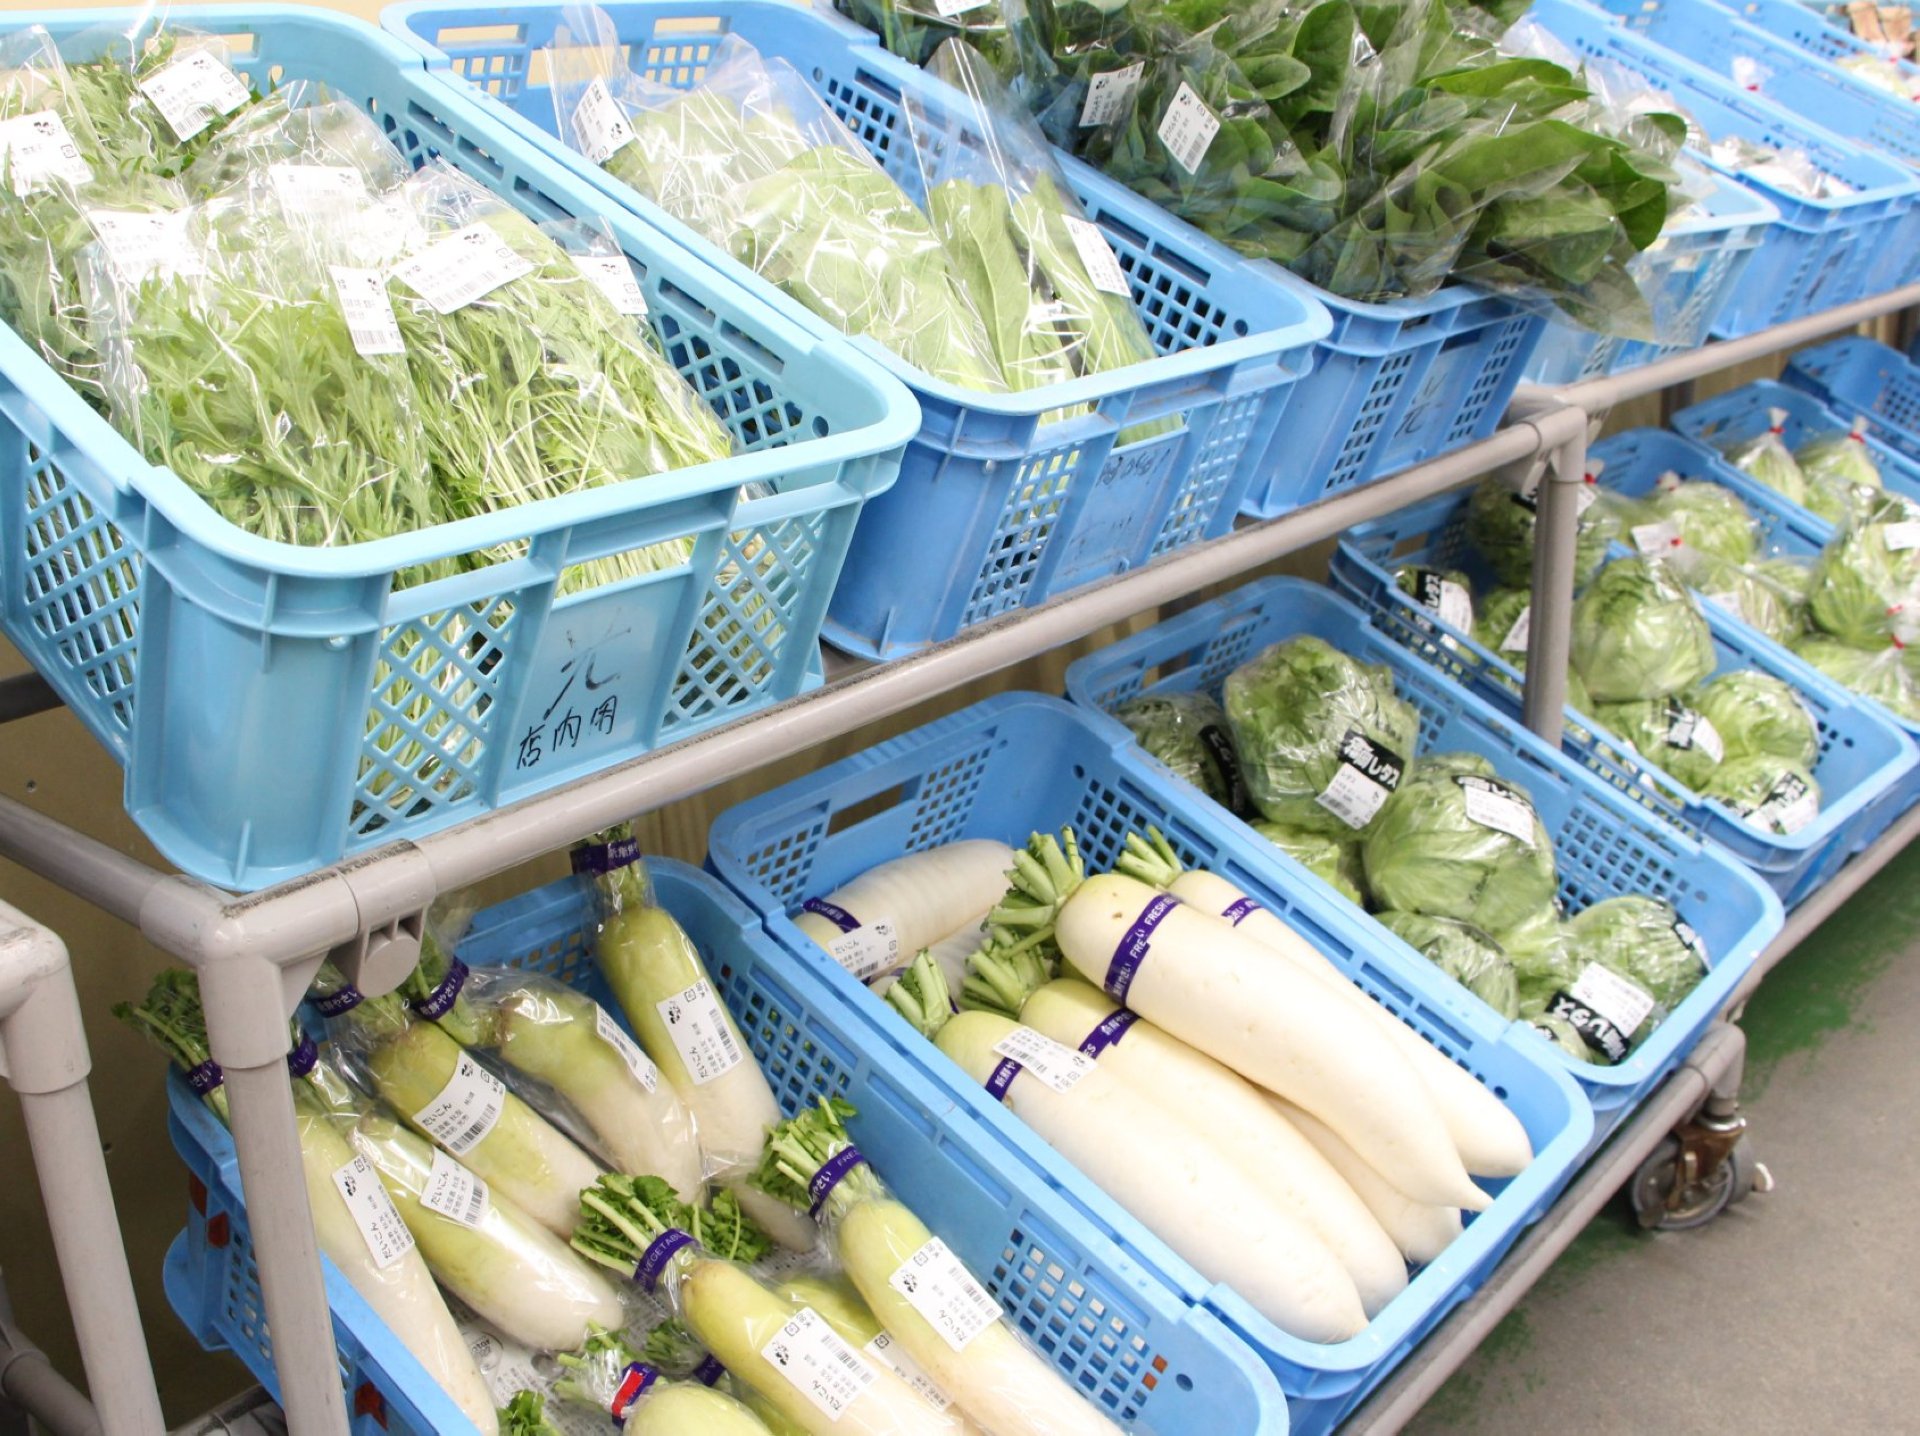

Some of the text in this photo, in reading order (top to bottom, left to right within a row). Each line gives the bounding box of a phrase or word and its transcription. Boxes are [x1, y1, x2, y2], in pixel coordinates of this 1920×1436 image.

[516, 694, 618, 770] 店内用
[1143, 901, 1166, 925] FRESH
[834, 939, 859, 953] だいこん
[686, 1045, 708, 1079] だいこん
[421, 1099, 452, 1128] だいこん
[429, 1170, 449, 1205] だいこん
[366, 1221, 393, 1260] だいこん
[936, 1308, 966, 1342] だいこん
[810, 1378, 841, 1411] だいこん
